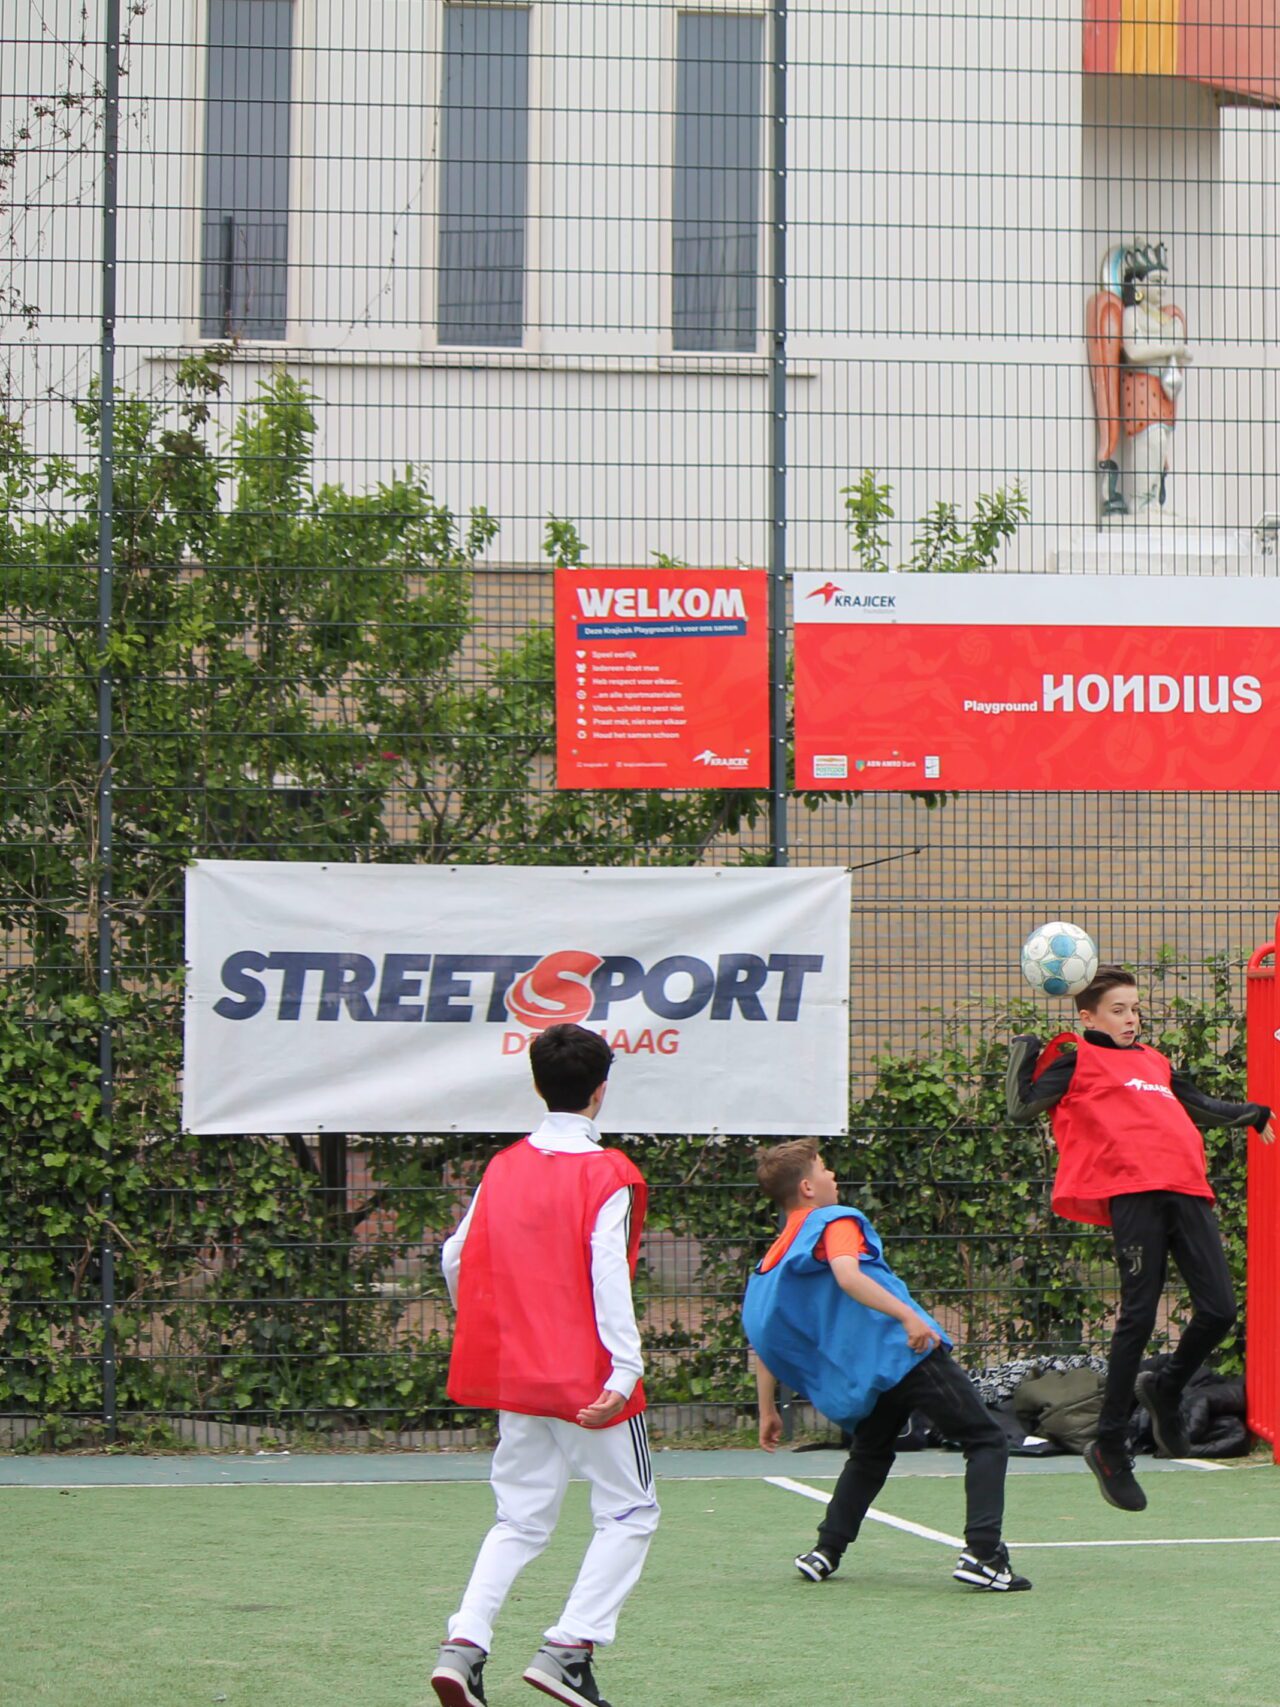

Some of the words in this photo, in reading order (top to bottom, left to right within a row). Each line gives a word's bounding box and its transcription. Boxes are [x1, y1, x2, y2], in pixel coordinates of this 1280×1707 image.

[576, 588, 746, 618] WELKOM
[834, 595, 896, 607] KRAJICEK
[634, 625, 674, 635] Playground
[963, 700, 1038, 714] Playground
[602, 1029, 680, 1054] AAG
